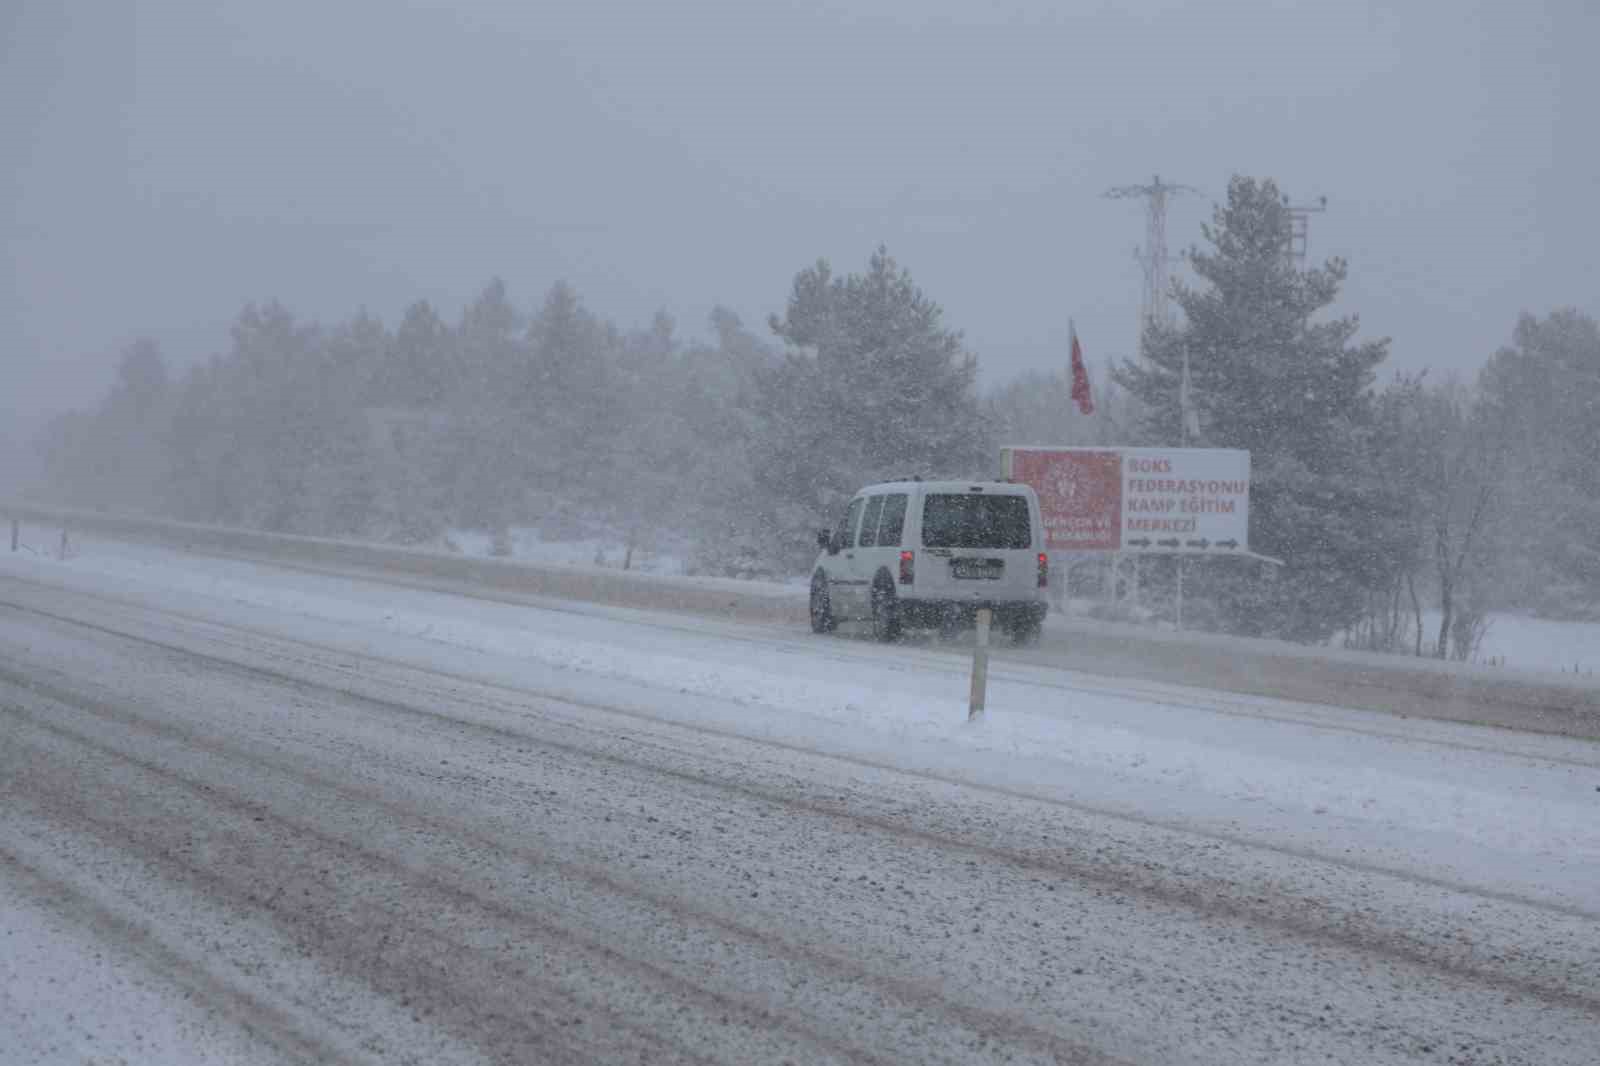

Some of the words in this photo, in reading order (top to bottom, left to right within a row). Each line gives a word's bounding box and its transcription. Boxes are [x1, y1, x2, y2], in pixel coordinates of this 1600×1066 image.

[1128, 458, 1172, 473] BOKS
[1128, 479, 1246, 494] FEDERASYONU
[1127, 499, 1175, 513] KAMP
[1180, 496, 1236, 513] EĞİTİM
[1127, 516, 1197, 532] MERKEZİ
